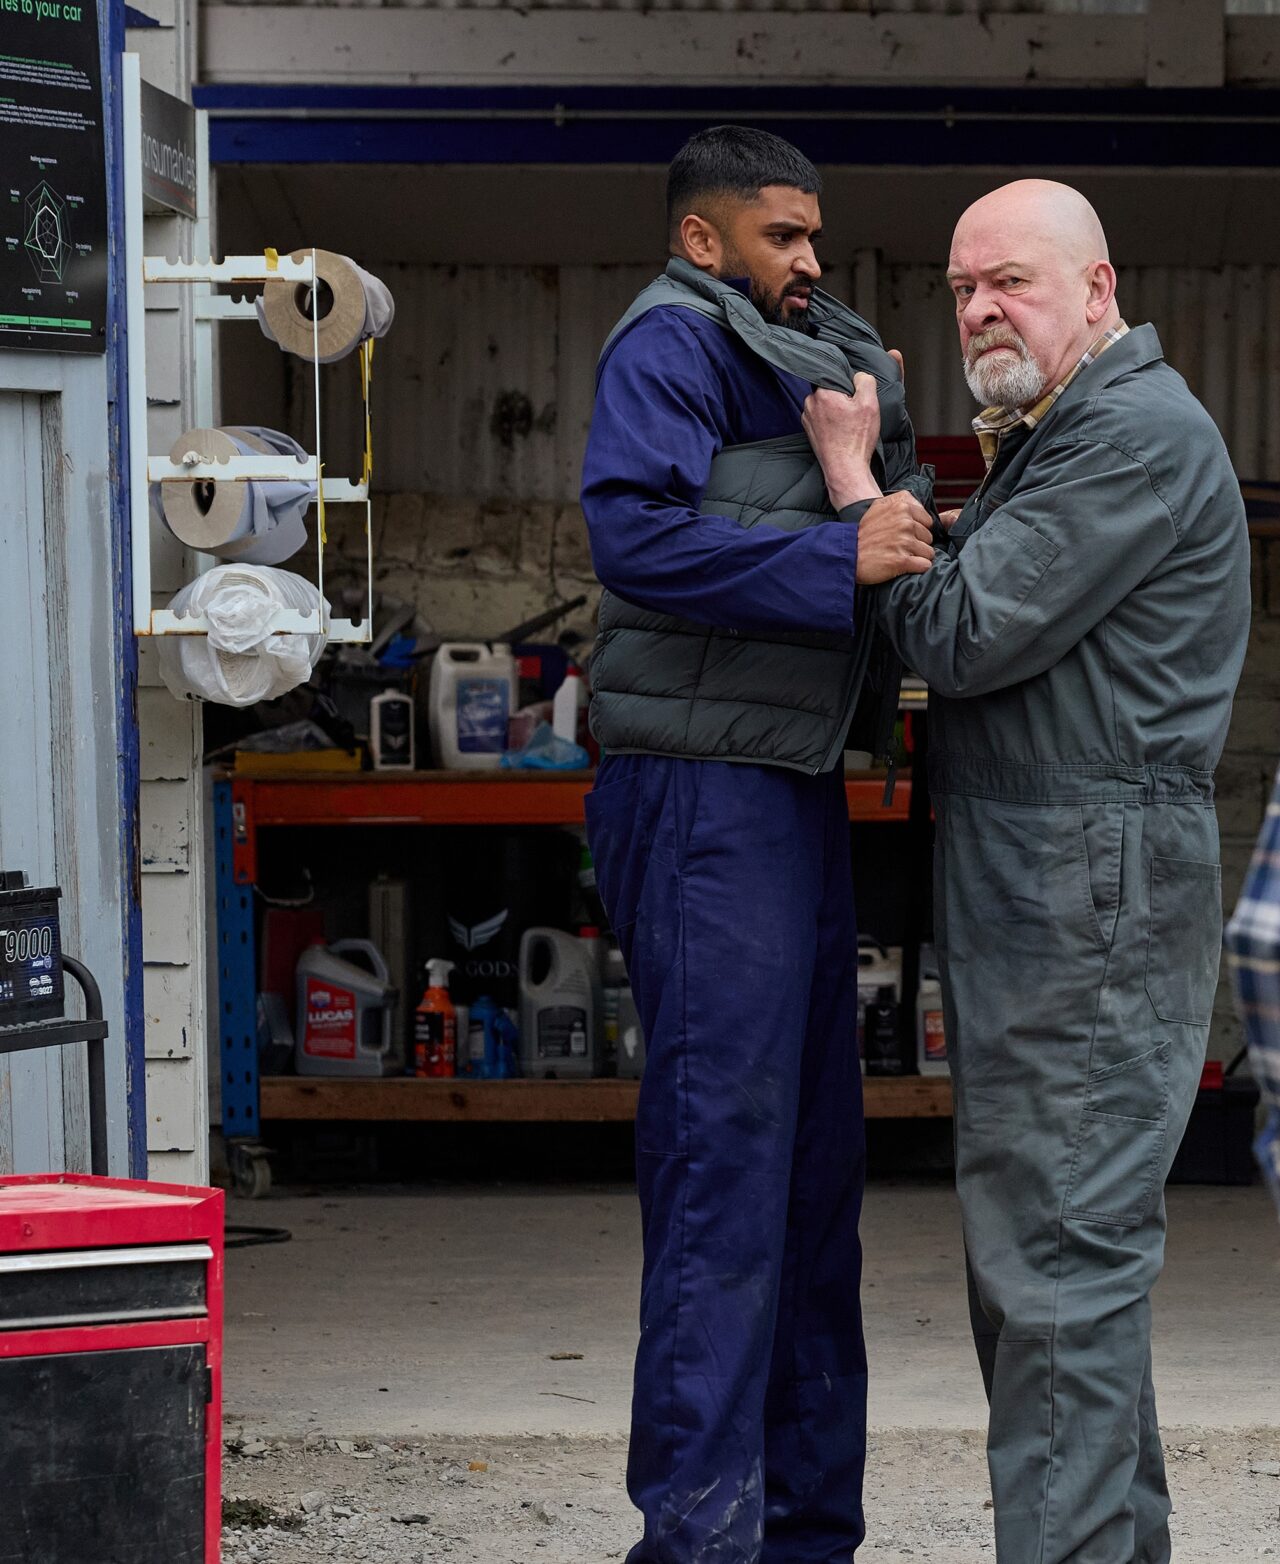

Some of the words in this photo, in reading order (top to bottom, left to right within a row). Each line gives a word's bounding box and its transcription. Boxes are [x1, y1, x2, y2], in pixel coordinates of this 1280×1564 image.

[21, 0, 33, 14] to
[35, 1, 61, 21] your
[63, 5, 82, 21] car
[142, 132, 196, 192] onsumables
[5, 926, 52, 963] 9000
[308, 1009, 353, 1023] LUCAS
